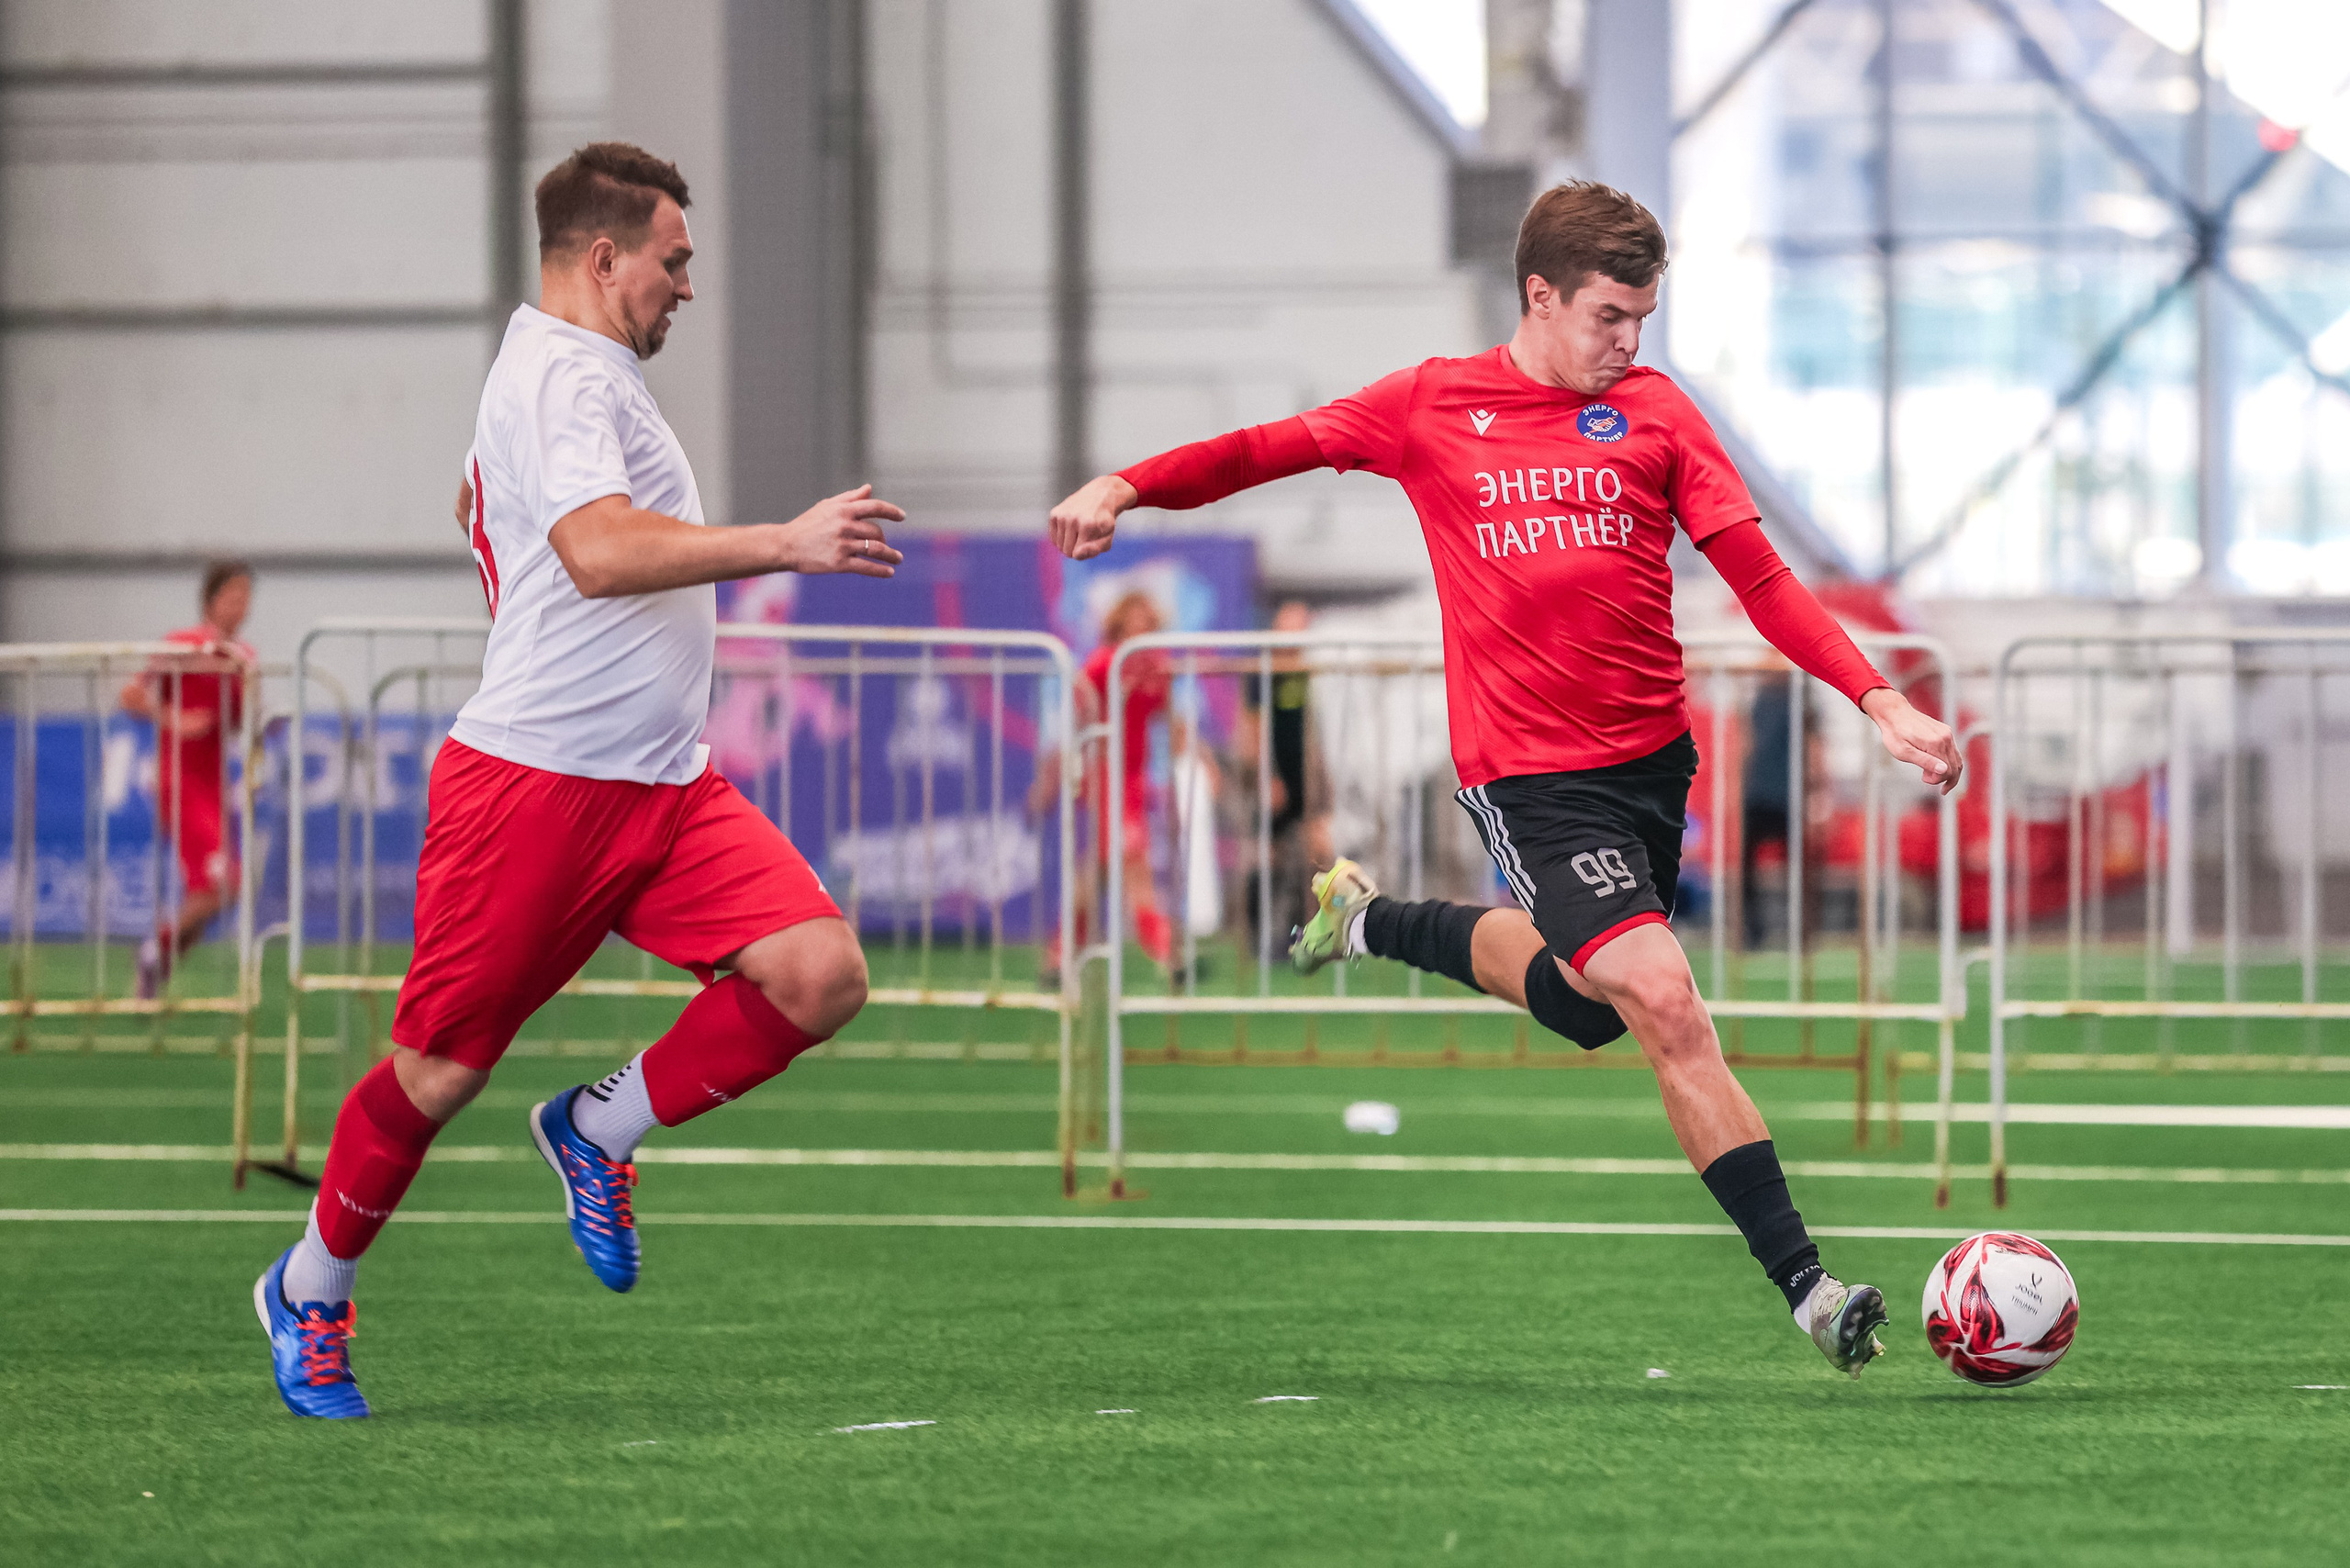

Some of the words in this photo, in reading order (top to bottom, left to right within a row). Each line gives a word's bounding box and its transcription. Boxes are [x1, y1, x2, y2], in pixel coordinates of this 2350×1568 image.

[1583, 404, 1619, 417] ЭНЕРГО
[1583, 431, 1624, 442] ПАРТНЕР
[1474, 467, 1622, 508] ЭНЕРГО
[1474, 507, 1634, 559] ПАРТНЁР
[1571, 847, 1637, 898] 99
